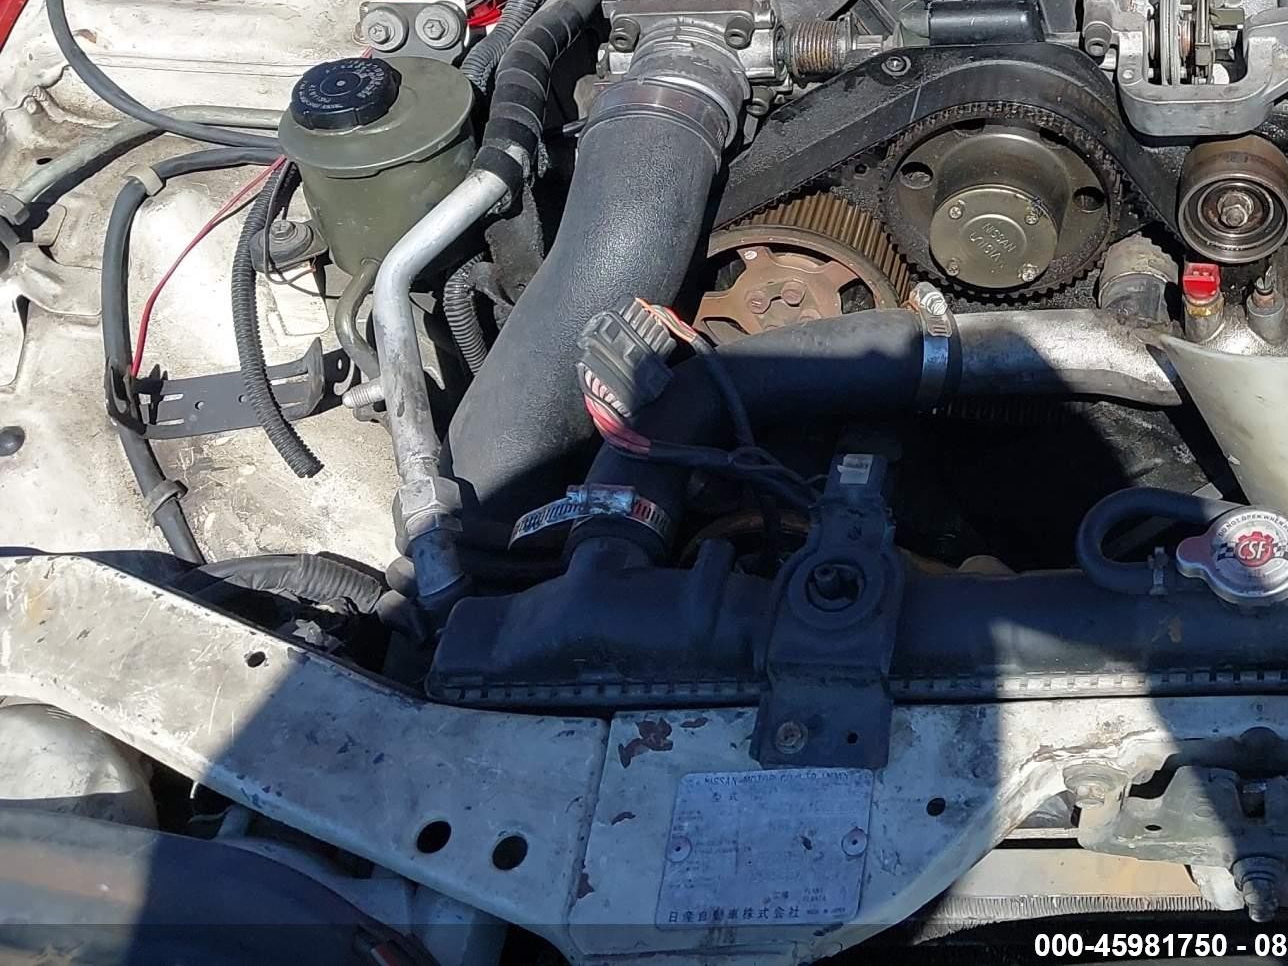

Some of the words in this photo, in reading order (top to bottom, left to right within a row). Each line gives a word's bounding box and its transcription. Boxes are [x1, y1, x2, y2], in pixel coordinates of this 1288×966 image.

[982, 223, 1016, 252] NISSAN
[1263, 514, 1283, 526] WHEN
[1237, 540, 1267, 560] CSF
[703, 775, 738, 786] NISSAN
[668, 906, 800, 923] 日産自動車株式会社
